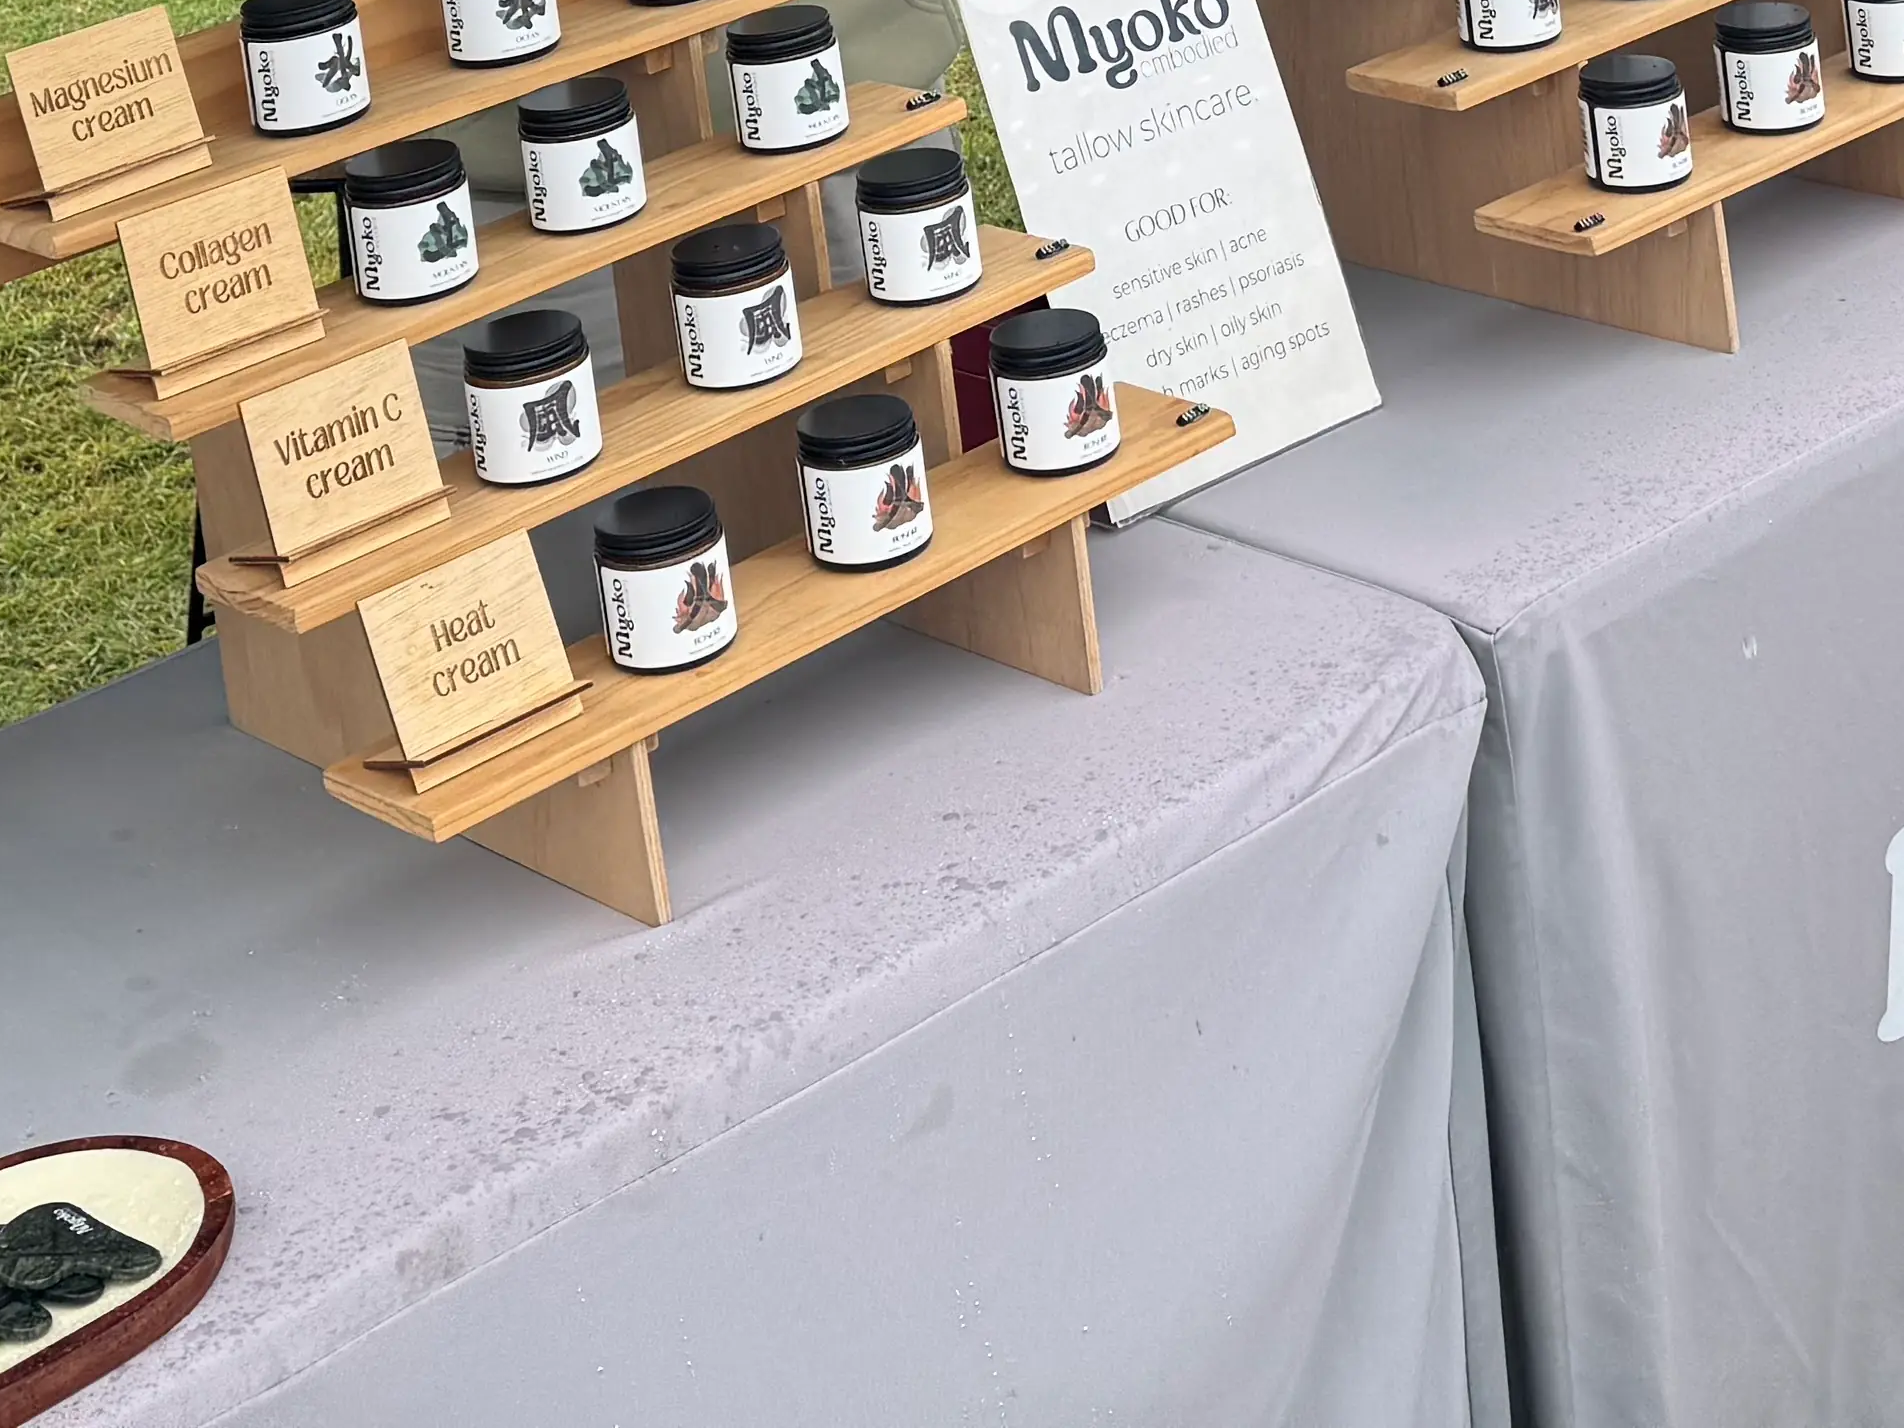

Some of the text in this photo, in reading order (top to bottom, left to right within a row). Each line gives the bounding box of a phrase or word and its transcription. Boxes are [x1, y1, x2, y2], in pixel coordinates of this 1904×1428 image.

[1140, 25, 1239, 78] embodied
[1856, 8, 1875, 68] Myoko
[30, 47, 173, 117] Magnesium
[71, 92, 154, 142] cream
[258, 50, 280, 122] Myoko
[742, 72, 762, 141] Myoko
[1734, 60, 1754, 122] Myoko
[1049, 84, 1259, 174] tallow skincare.
[1606, 115, 1627, 180] Myoko
[529, 150, 547, 223] Myoko
[1124, 187, 1233, 243] GOOD FOR:
[159, 218, 273, 280] Collagen
[361, 216, 383, 291] Myoko
[867, 221, 887, 292] Myoko
[1113, 261, 1183, 299] sensitive
[1184, 246, 1218, 271] skin
[1229, 228, 1268, 254] acne
[184, 261, 273, 315] cream
[1103, 309, 1164, 345] eczema
[1176, 280, 1228, 317] rashes
[1238, 252, 1305, 294] psoriasis
[683, 304, 704, 379] Myoko
[1146, 345, 1173, 369] dry
[1176, 331, 1209, 356] skin
[1221, 316, 1247, 341] oily
[1249, 301, 1283, 327] skin
[1179, 362, 1230, 395] marks
[1242, 342, 1287, 372] aging
[1288, 321, 1331, 351] spots
[273, 391, 403, 468] Vitamin C
[470, 393, 488, 471] Myoko
[1007, 387, 1029, 461] Myoko
[305, 443, 395, 500] cream
[813, 477, 836, 554] Myoko
[430, 599, 496, 653] Heat
[612, 578, 634, 659] Myoko
[432, 635, 521, 698] cream
